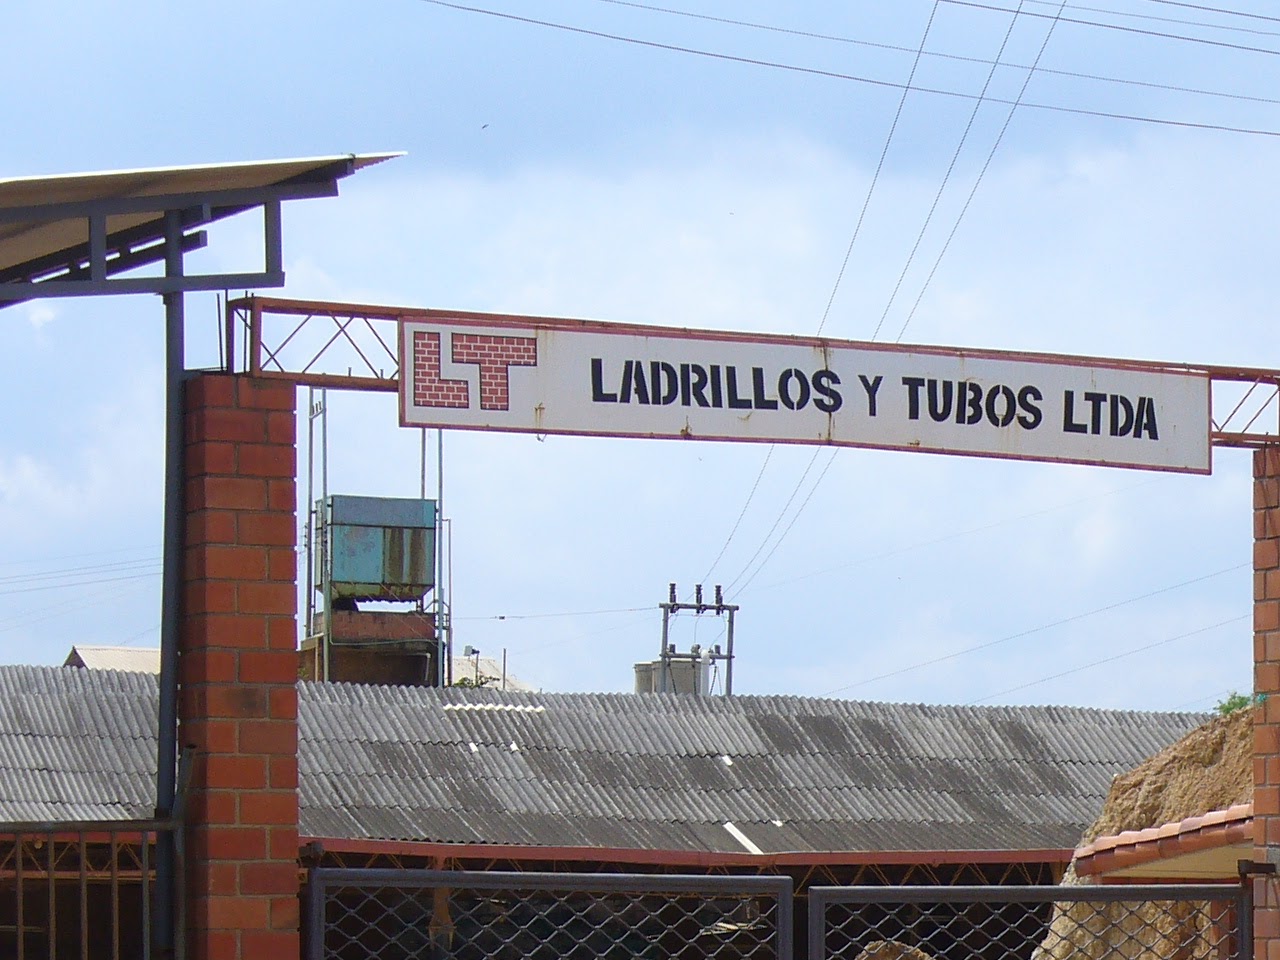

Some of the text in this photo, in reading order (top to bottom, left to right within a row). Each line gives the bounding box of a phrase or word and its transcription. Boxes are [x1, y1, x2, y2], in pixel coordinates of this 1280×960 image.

[590, 357, 1159, 440] LADRILLOS Y TUBOS LTDA
